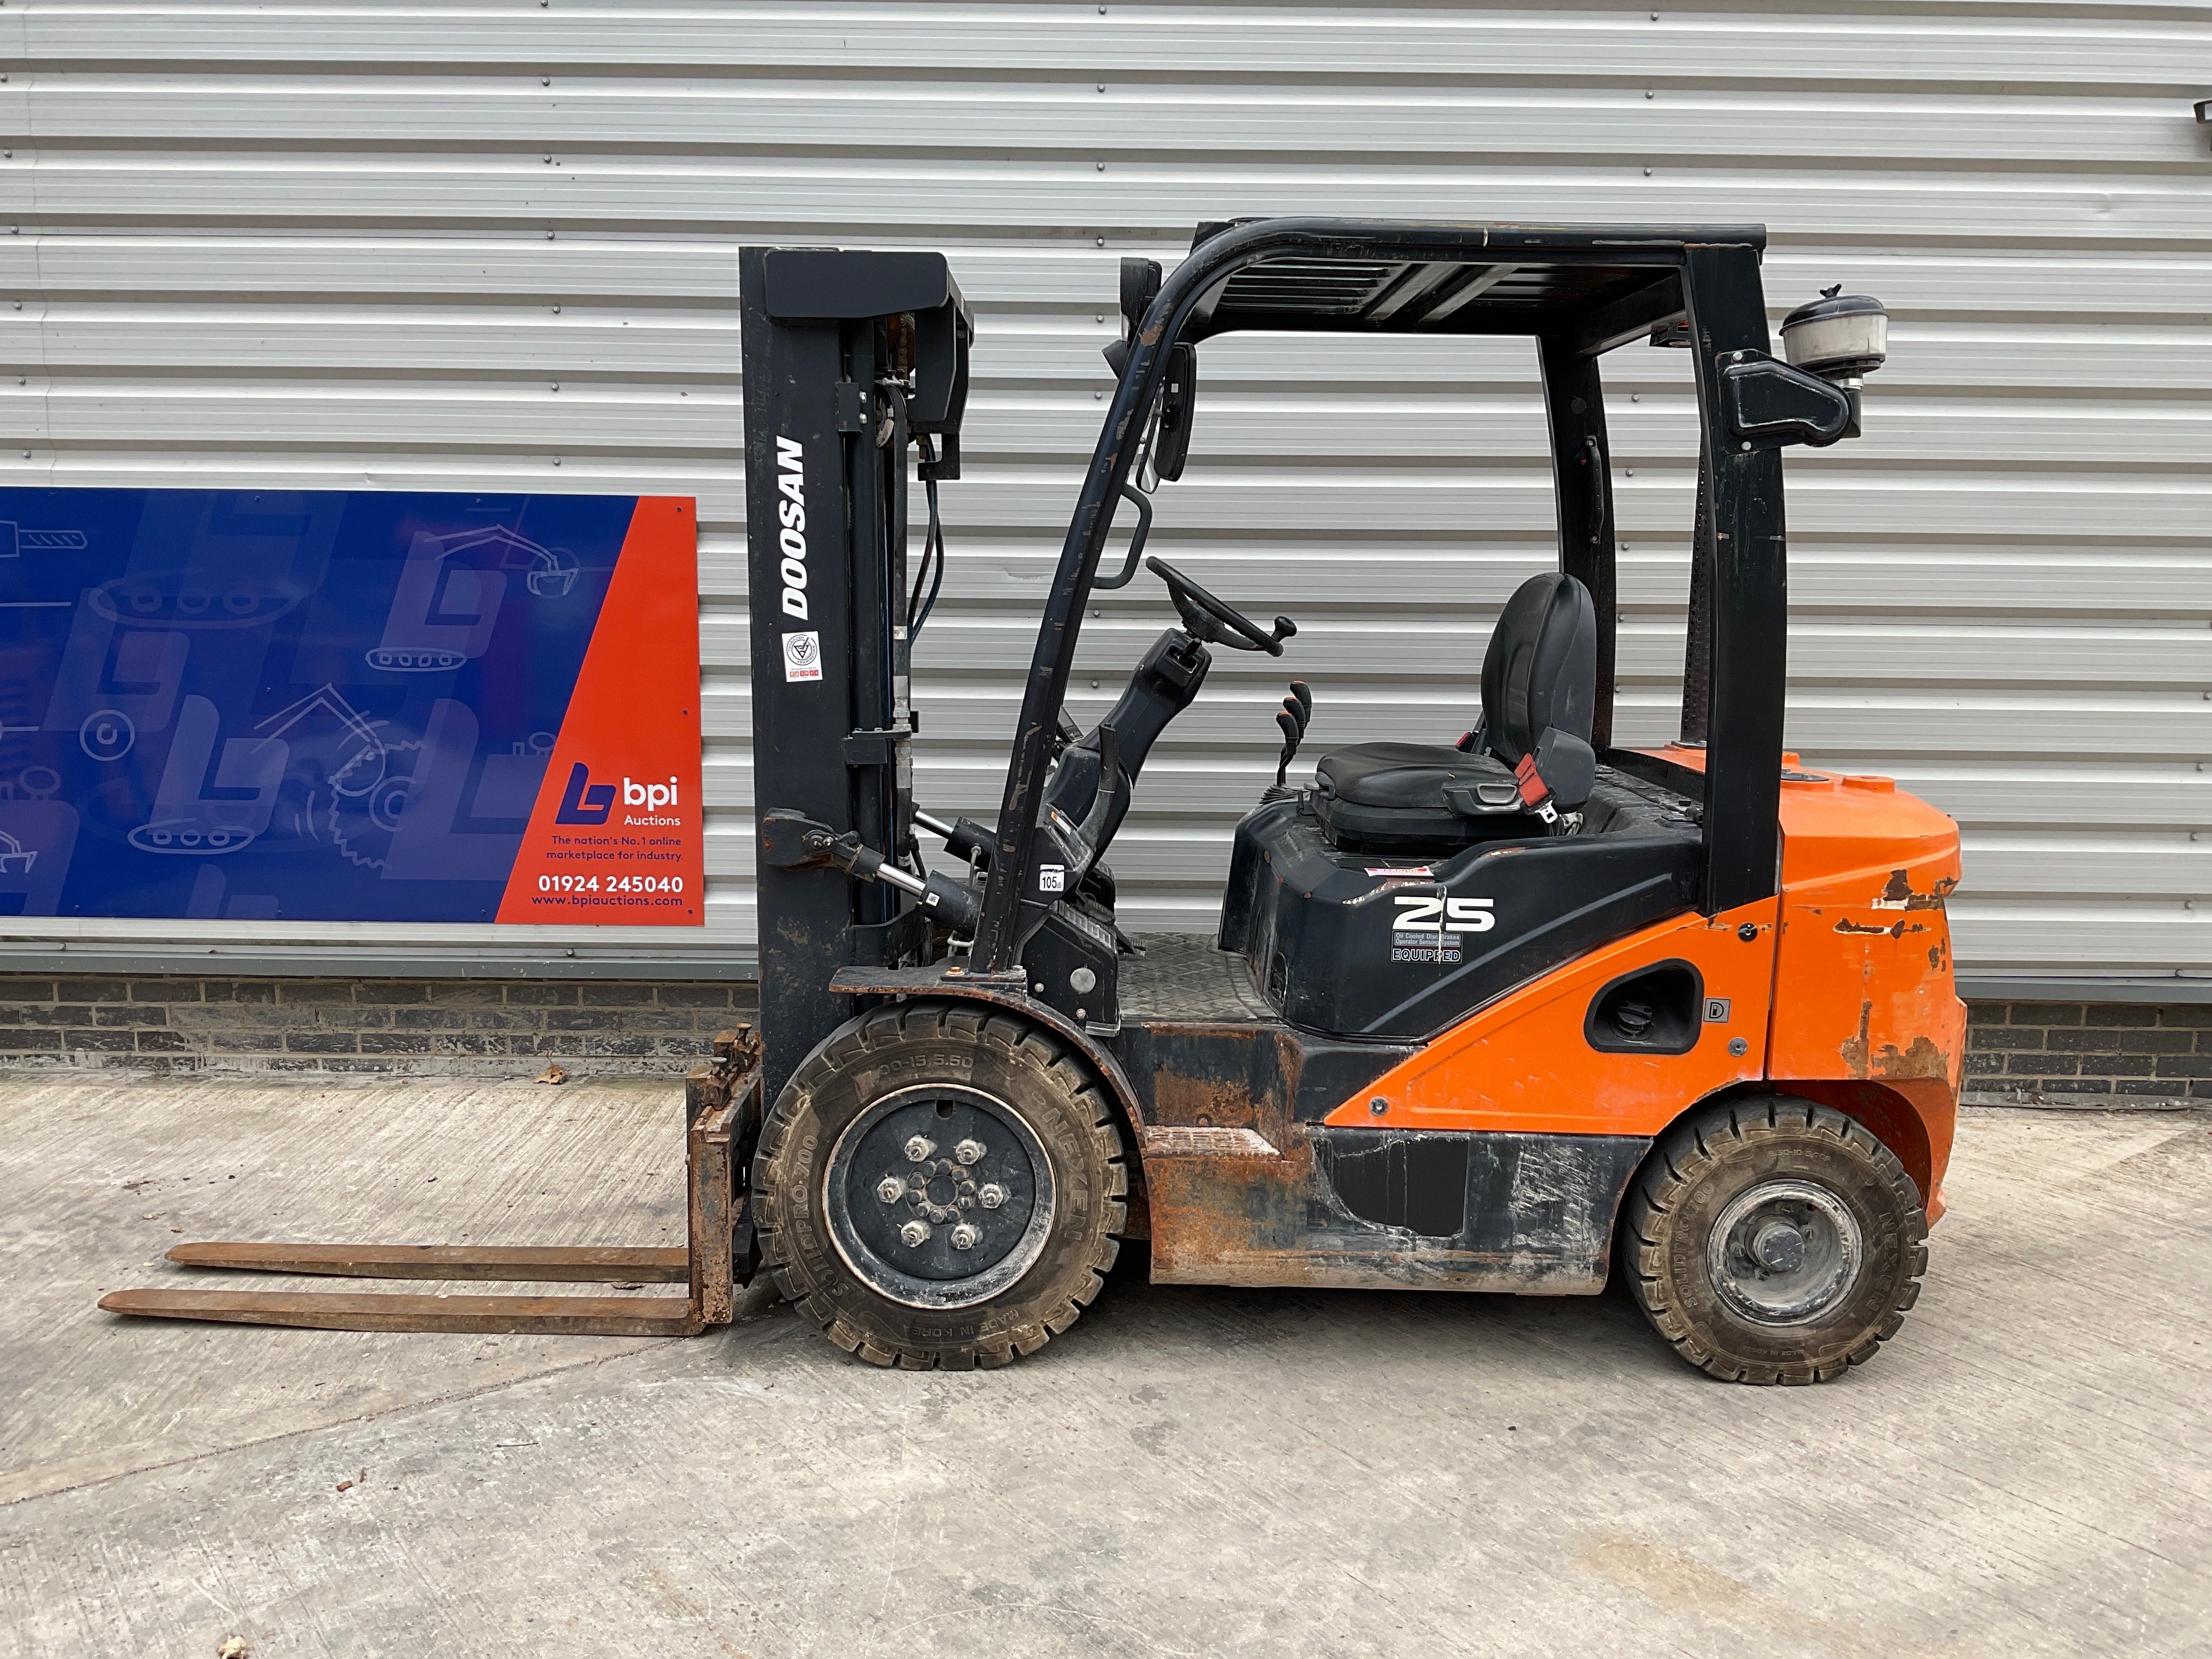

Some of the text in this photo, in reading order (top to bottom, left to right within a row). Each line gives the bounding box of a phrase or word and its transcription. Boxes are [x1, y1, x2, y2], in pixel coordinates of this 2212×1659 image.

[776, 436, 808, 620] DOOSAN
[623, 776, 678, 811] bpi
[624, 815, 681, 826] Auctions
[551, 836, 571, 844] The
[574, 836, 618, 845] nation's
[649, 837, 681, 845] online
[546, 850, 683, 862] marketplace for industry.
[538, 875, 684, 893] 01924 245040
[531, 895, 683, 907] www.bpiauctions.com
[1392, 896, 1496, 932] 25
[1392, 948, 1461, 961] EQUIPPED
[862, 1053, 974, 1082] 700-15 5.50
[1042, 1107, 1088, 1241] NEXEN
[1673, 1182, 1714, 1308] SOLIDPRO 700
[1865, 1212, 1898, 1312] NEXEN
[961, 1325, 974, 1336] IN
